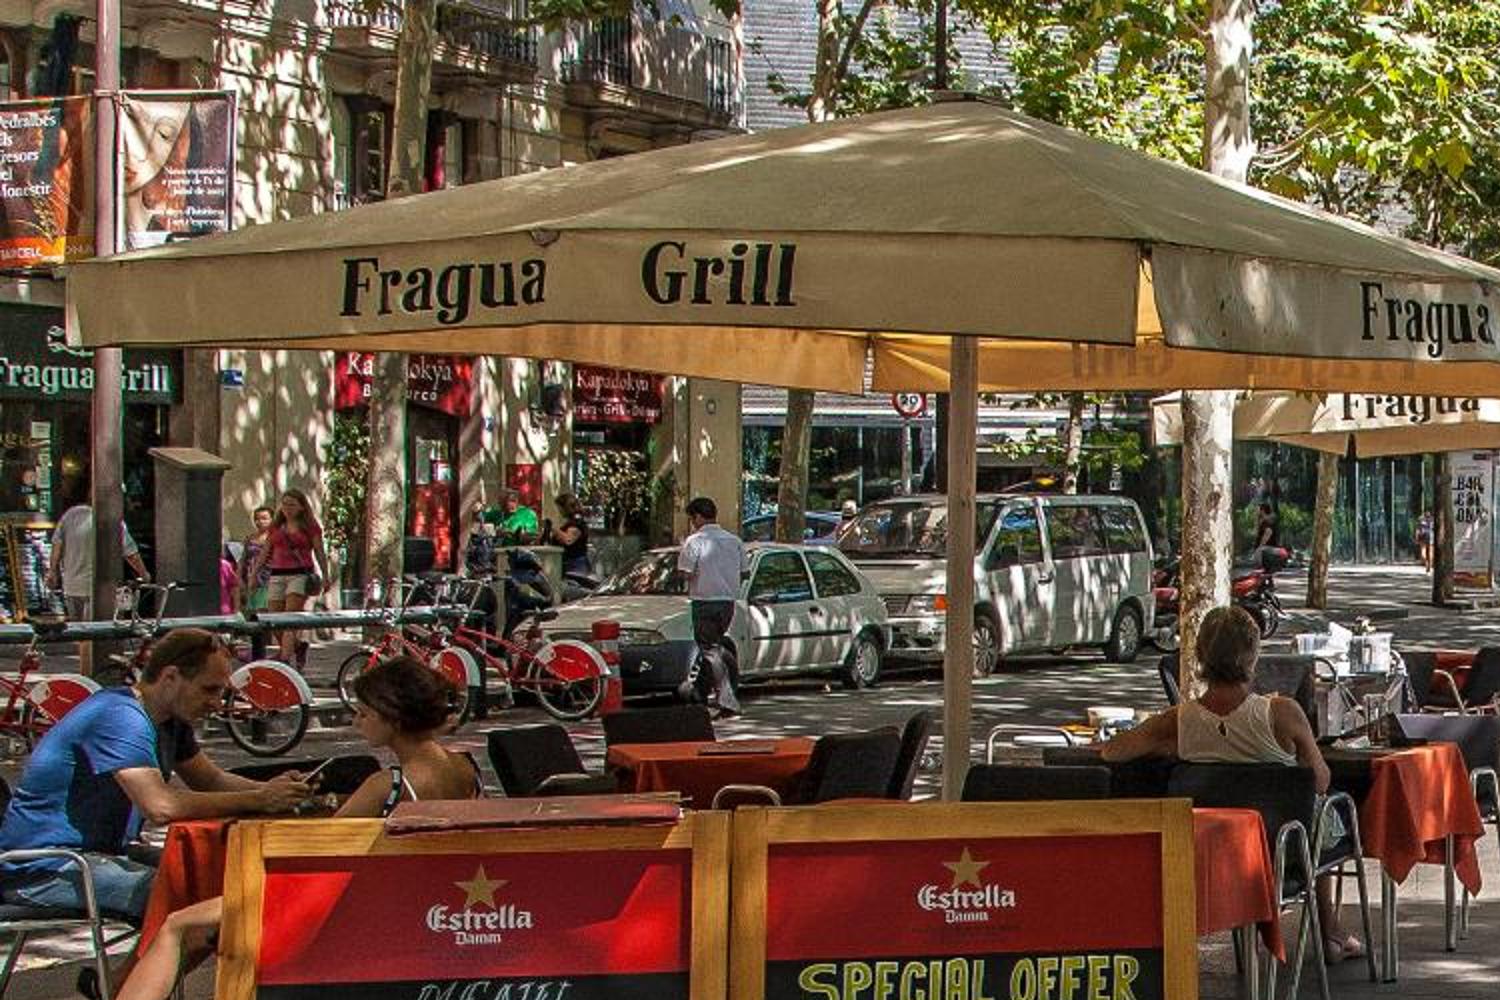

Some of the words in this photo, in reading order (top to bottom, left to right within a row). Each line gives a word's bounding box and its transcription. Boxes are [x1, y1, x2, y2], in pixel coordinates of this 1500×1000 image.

[0, 112, 57, 128] edralbes
[0, 149, 40, 164] resors
[340, 257, 547, 325] Fragua
[641, 240, 797, 307] Grill
[1360, 281, 1495, 359] Fragua
[916, 883, 1017, 911] Estrella
[425, 903, 535, 932] Estrella
[945, 909, 990, 924] Damm
[453, 931, 502, 945] Damm
